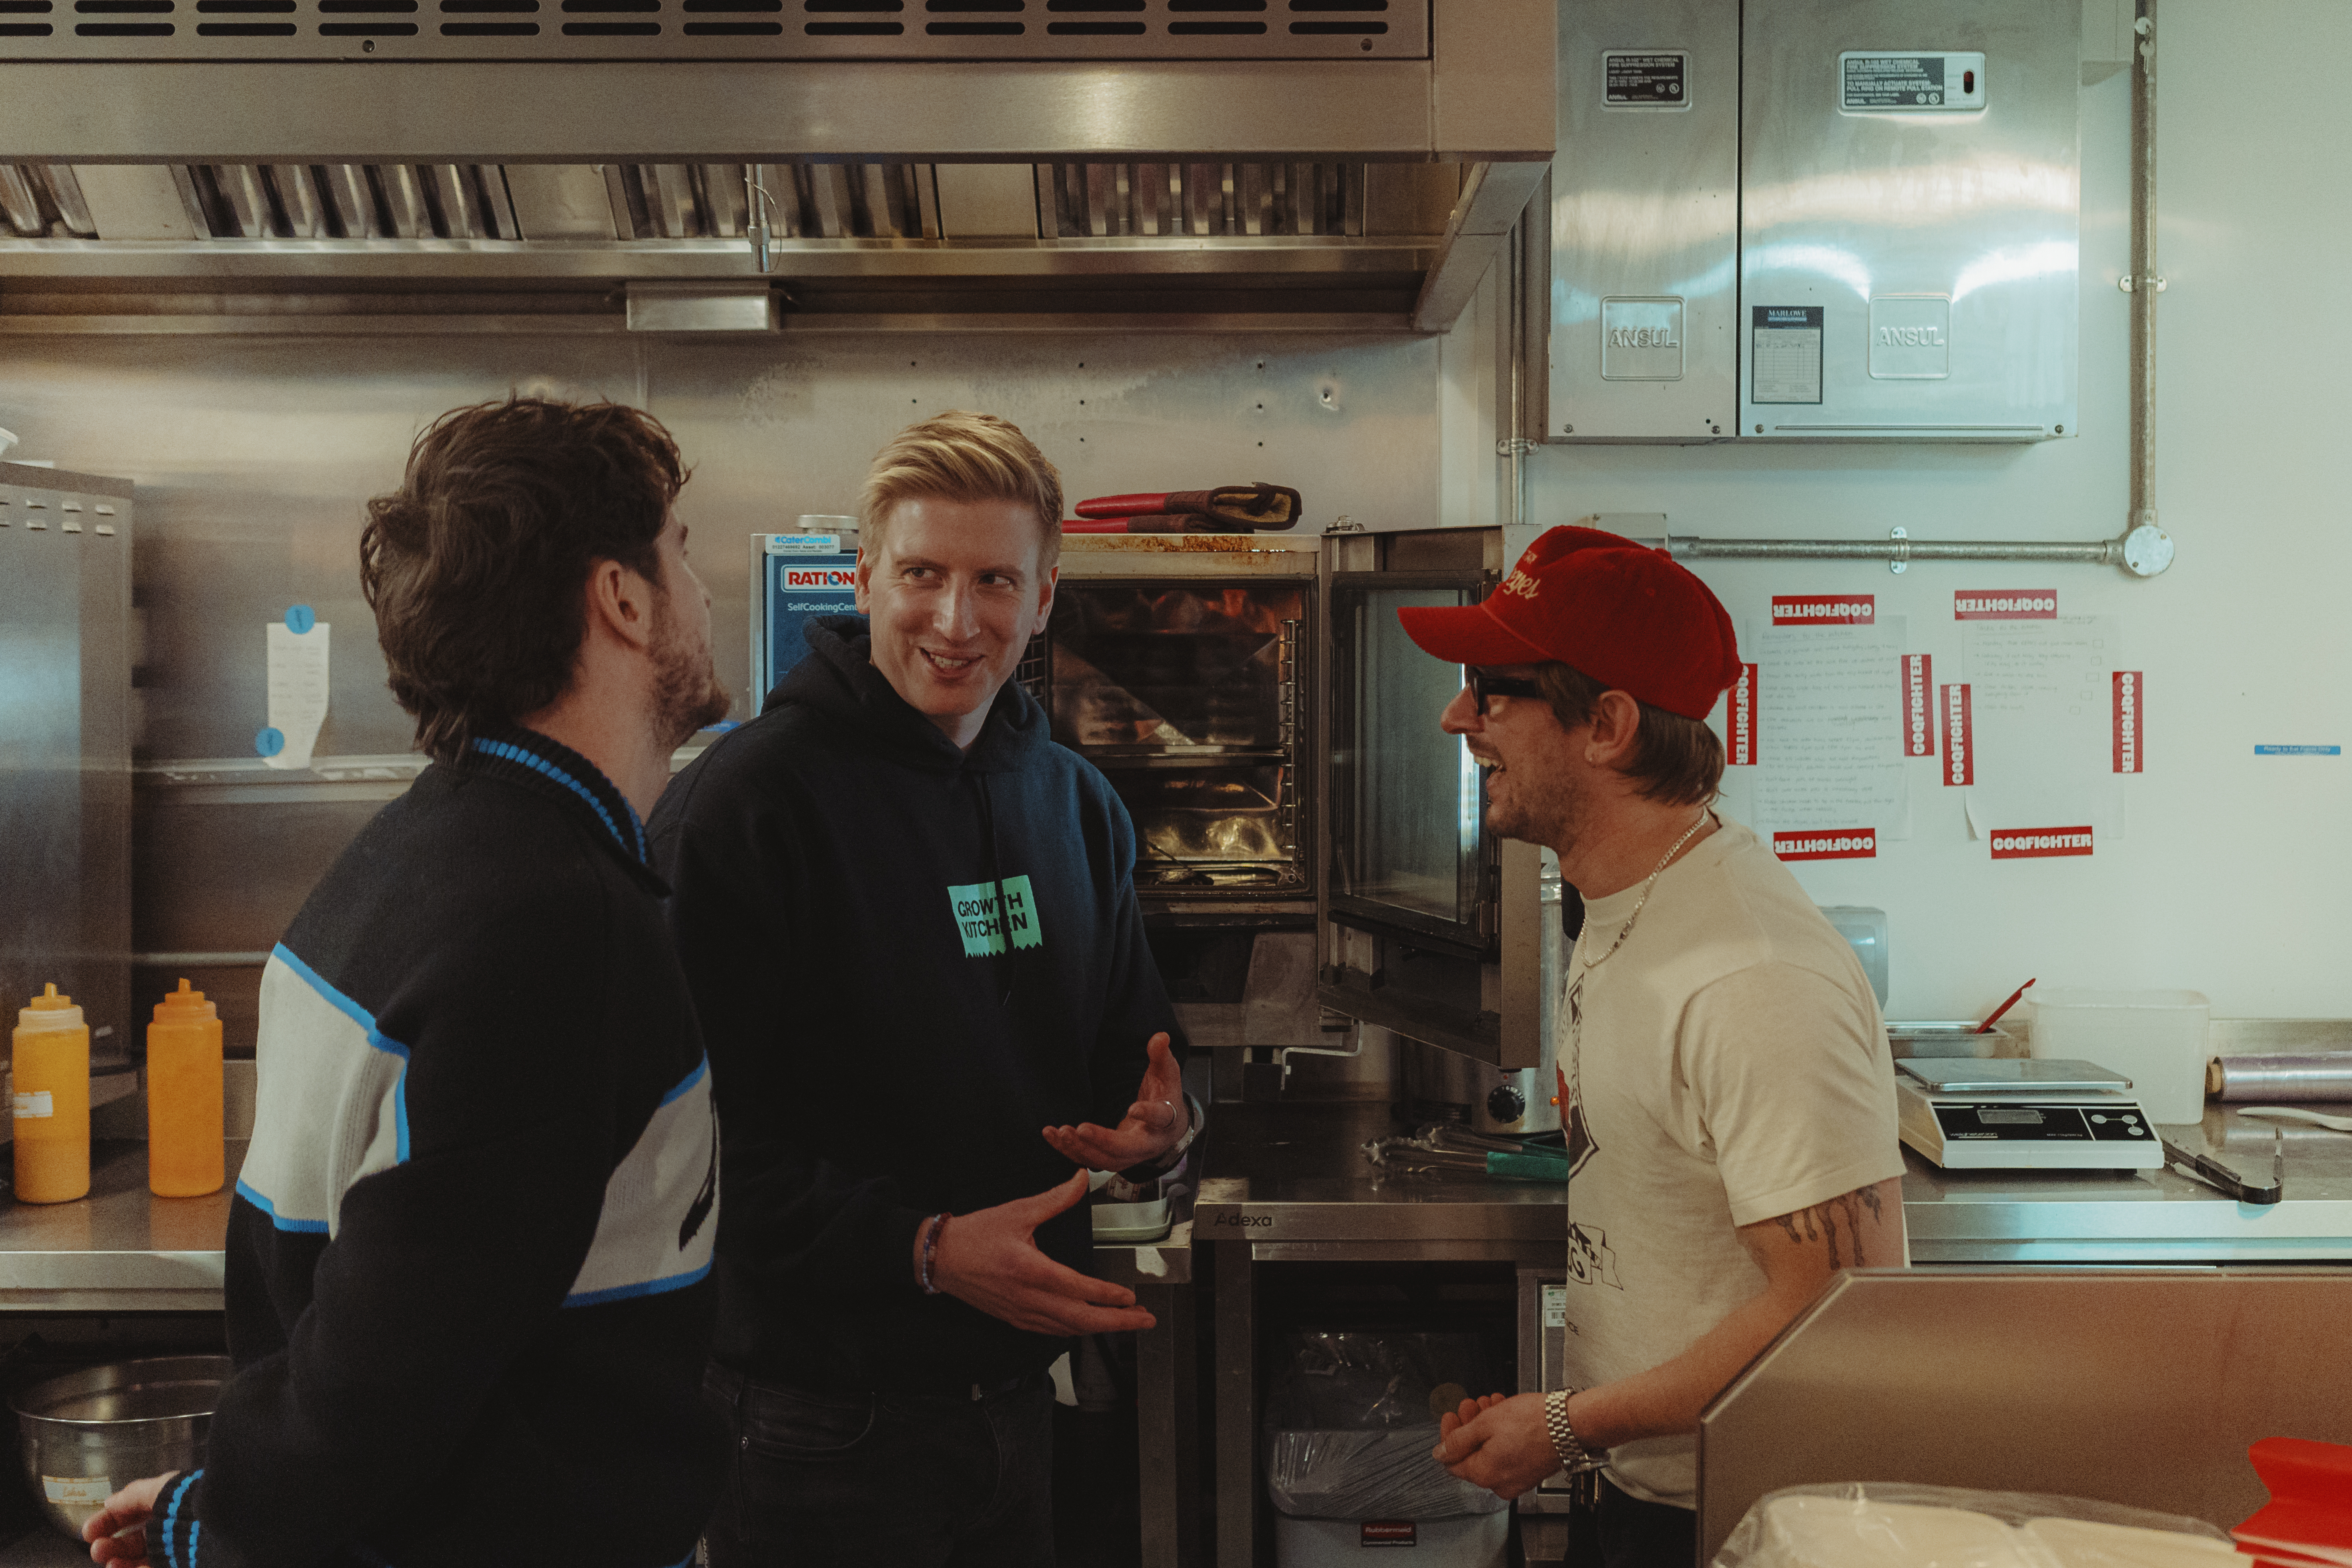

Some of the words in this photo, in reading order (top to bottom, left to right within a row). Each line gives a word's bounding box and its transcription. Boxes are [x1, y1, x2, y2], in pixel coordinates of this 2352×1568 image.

[1607, 327, 1679, 348] ANSUL
[1876, 327, 1944, 347] ANSUL
[781, 536, 831, 544] CaterCombi
[1774, 603, 1872, 617] COQFIGHTER
[1956, 597, 2055, 613] COQFIGHTER
[1910, 655, 1926, 754] COQFIGHTER
[2121, 673, 2135, 772] COQFIGHTER
[1949, 684, 1965, 784] COQFIGHTER
[1774, 837, 1874, 854] COQFIGHTER
[1991, 834, 2092, 851] COQFIGHTER
[962, 912, 1028, 938] KITCHN
[1214, 1213, 1272, 1227] Adexa
